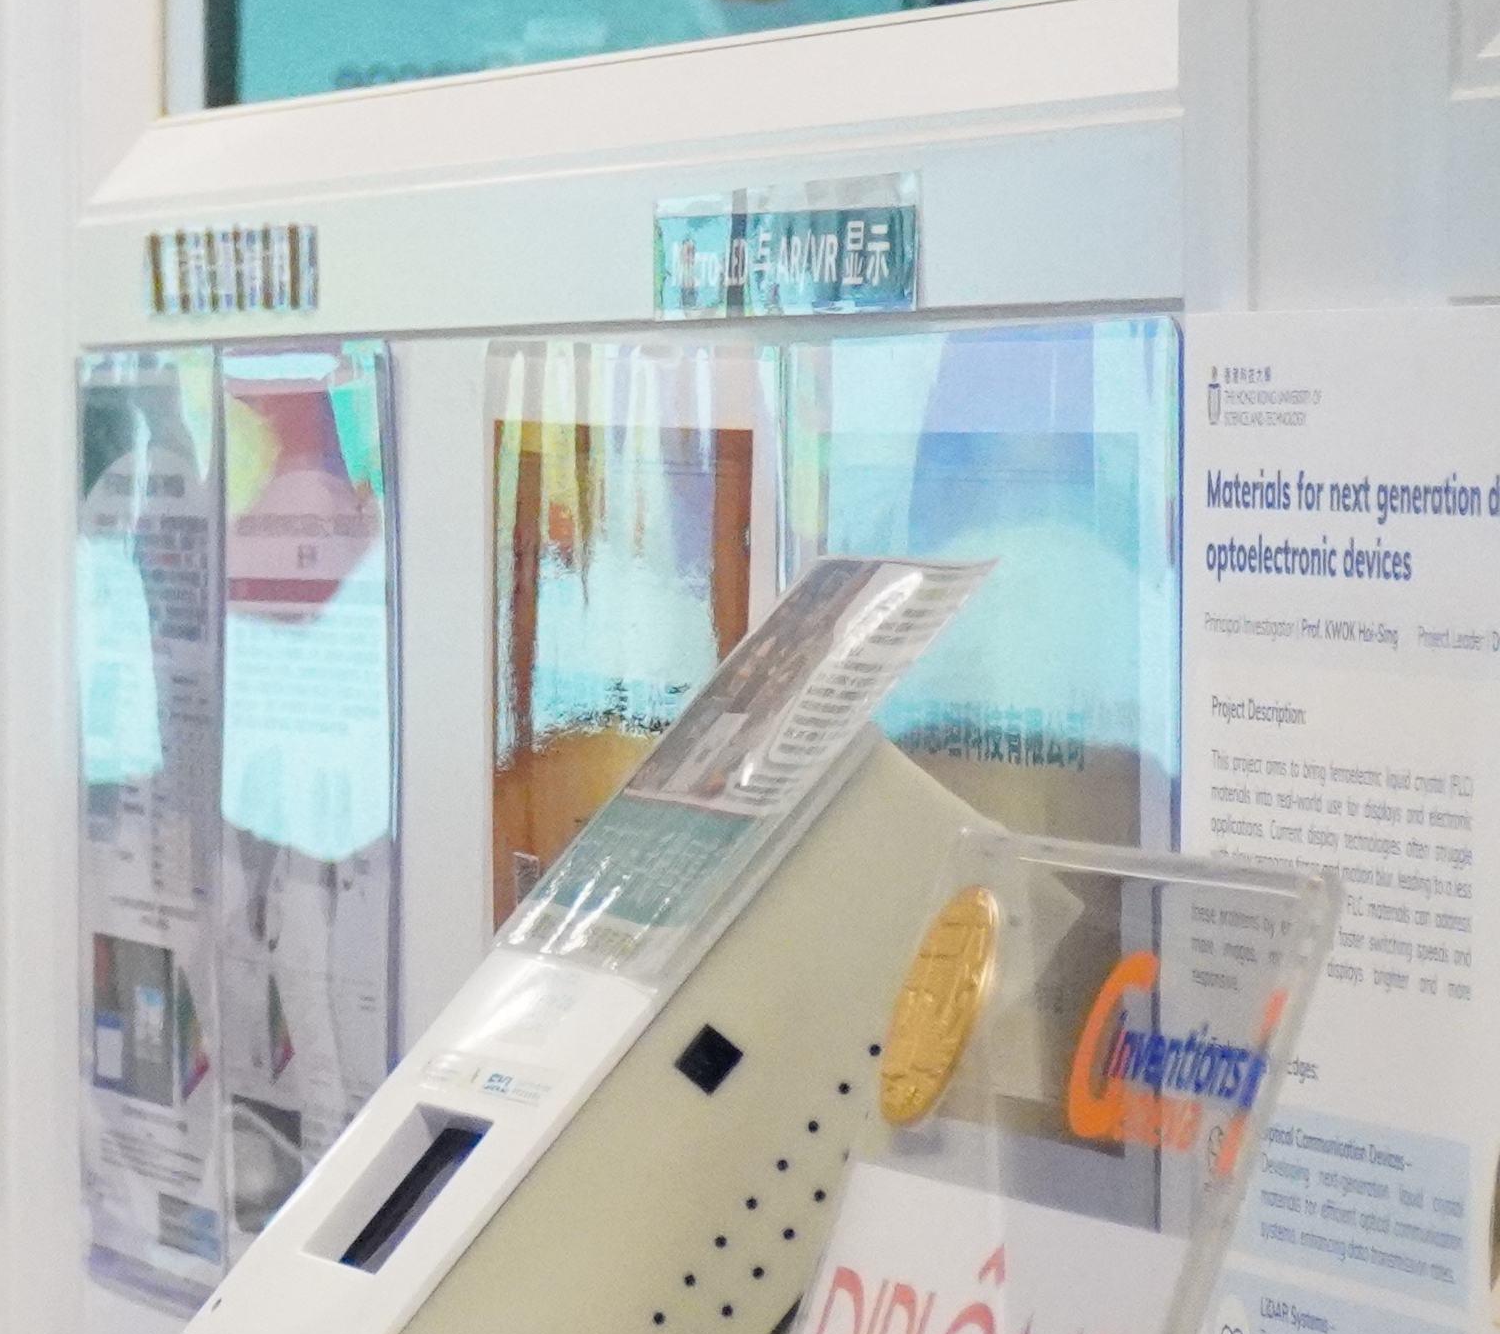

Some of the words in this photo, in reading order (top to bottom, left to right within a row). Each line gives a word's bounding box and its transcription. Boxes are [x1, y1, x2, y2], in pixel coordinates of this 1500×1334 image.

[779, 229, 838, 299] AR/VR
[842, 220, 890, 287] 显示
[1206, 469, 1291, 511] Materials
[1297, 470, 1323, 512] for
[1330, 475, 1370, 513] next
[1377, 473, 1482, 525] generation
[1206, 534, 1337, 582] optoelectronic
[1343, 537, 1412, 581] devices
[1301, 618, 1323, 638] Prof.
[1325, 621, 1356, 642] KWOK
[1211, 695, 1245, 726] Project
[1248, 698, 1306, 727] Description:
[1211, 749, 1229, 770] This
[1232, 754, 1262, 778] project
